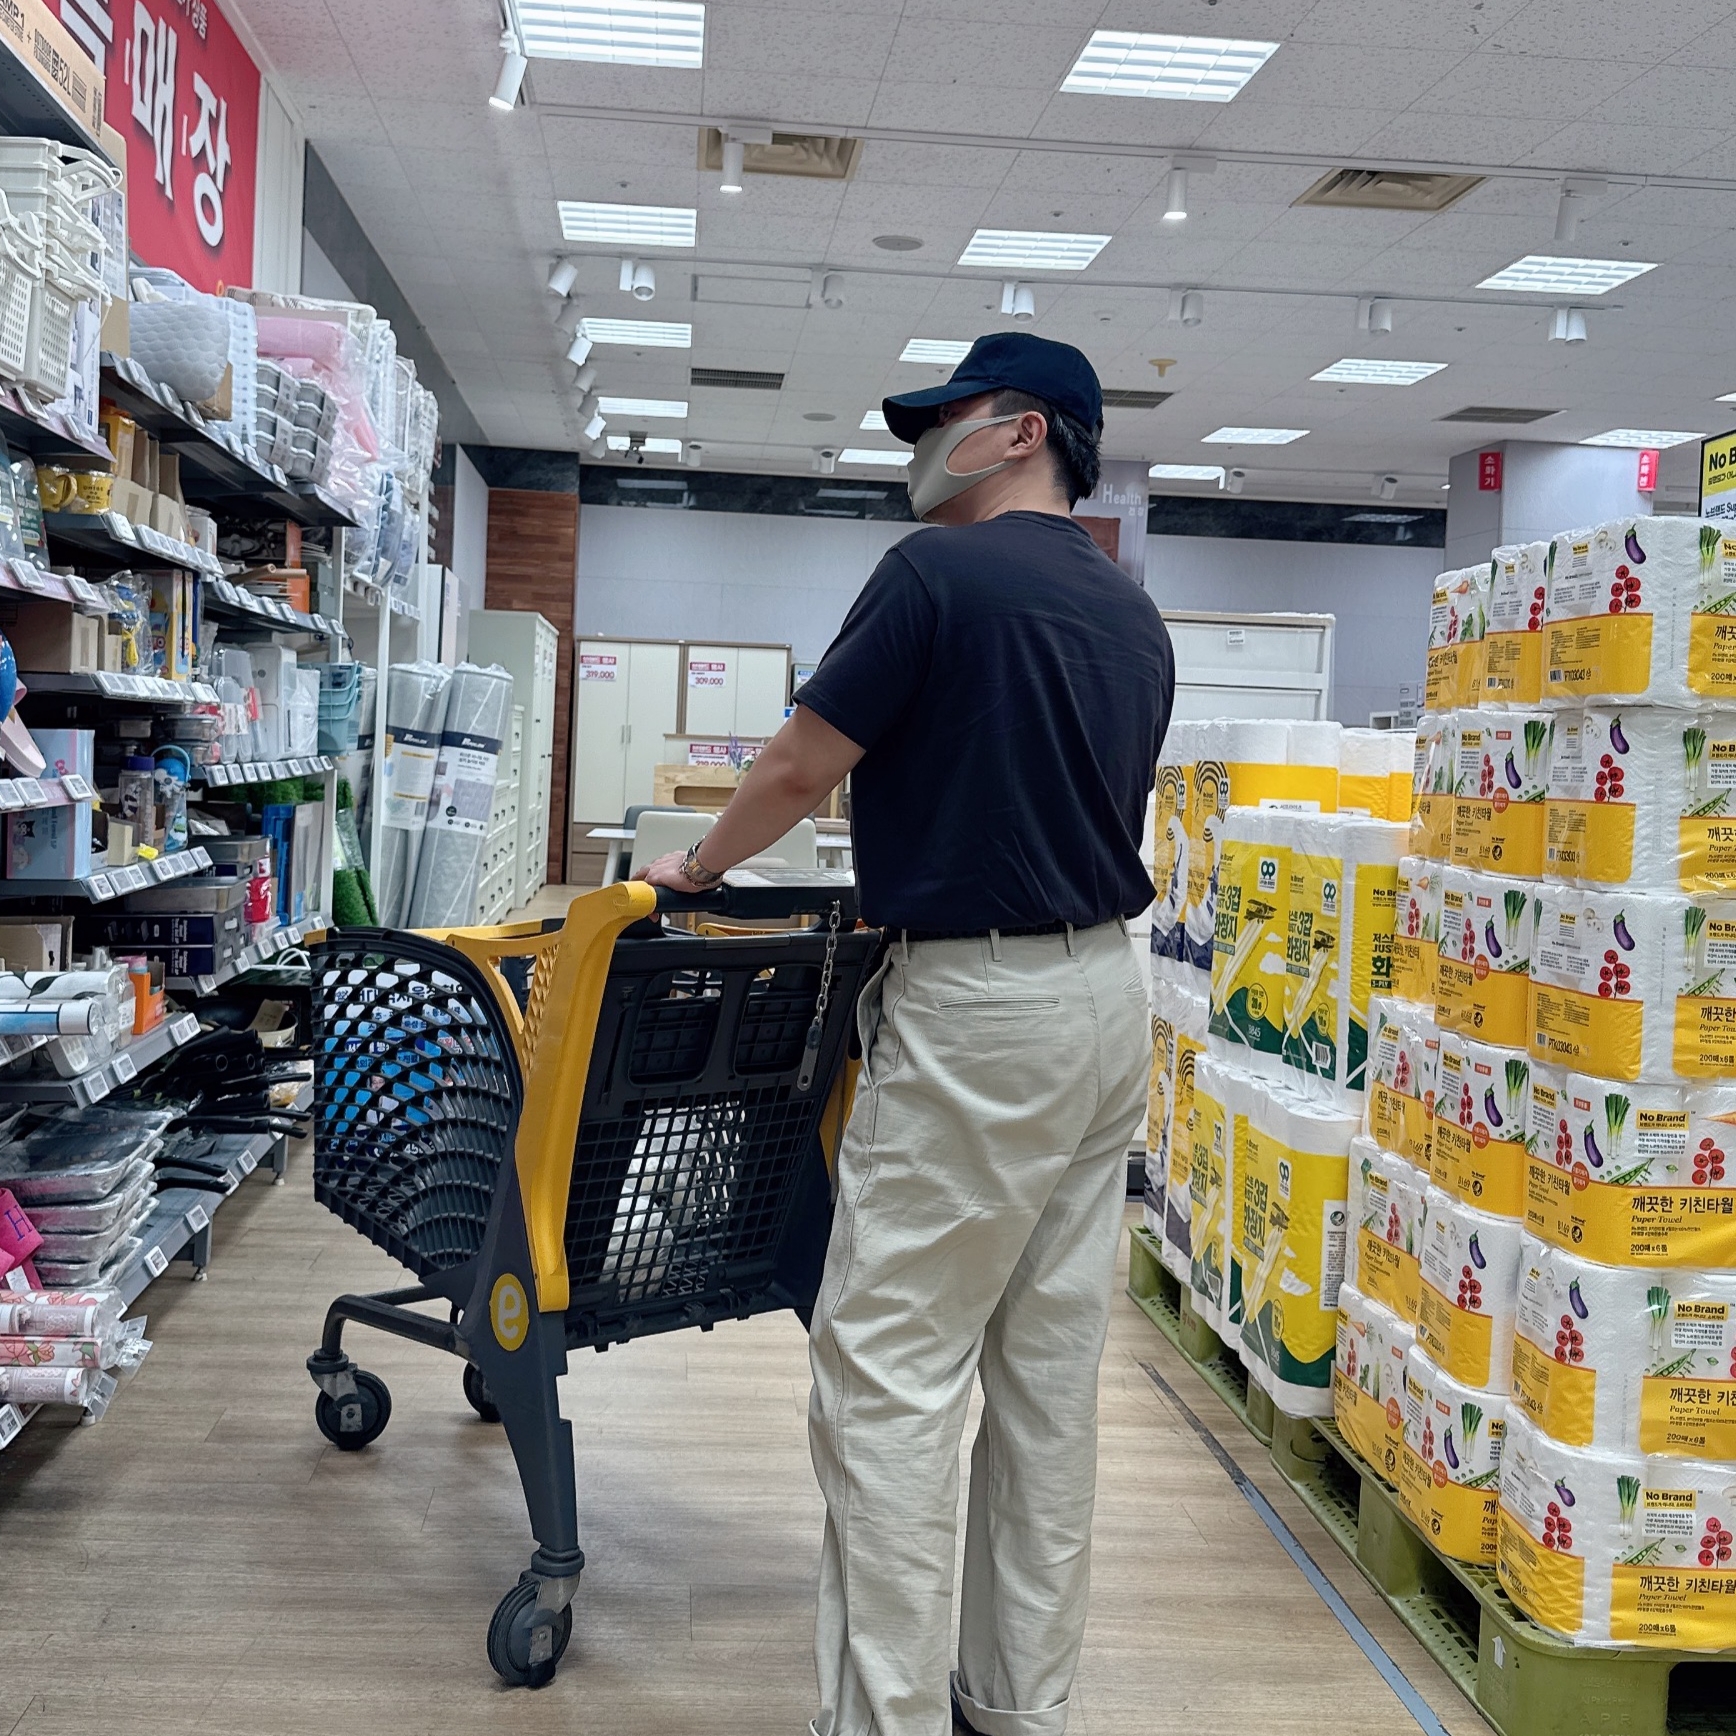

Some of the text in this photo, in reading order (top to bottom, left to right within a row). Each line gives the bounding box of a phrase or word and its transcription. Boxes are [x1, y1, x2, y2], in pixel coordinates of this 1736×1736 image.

[1709, 452, 1726, 472] No
[1484, 456, 1496, 486] 소화기
[1102, 483, 1142, 506] Health
[1372, 944, 1393, 954] JUS
[1700, 1024, 1720, 1034] Paper
[1639, 1113, 1687, 1123] No Brand
[1529, 1165, 1546, 1185] 깨끗한
[1547, 1173, 1571, 1196] 키친타월
[1631, 1196, 1734, 1214] 깨끗한 키친타월
[1631, 1215, 1683, 1224] Paper Towel
[1677, 1303, 1725, 1315] No Brand
[1669, 1387, 1711, 1405] 깨끗한
[1669, 1405, 1720, 1416] Paper Towel
[1646, 1491, 1693, 1502] No Brand
[1640, 1575, 1736, 1594] 깨끗한 키친타월
[1639, 1594, 1687, 1602] Paper Towel
